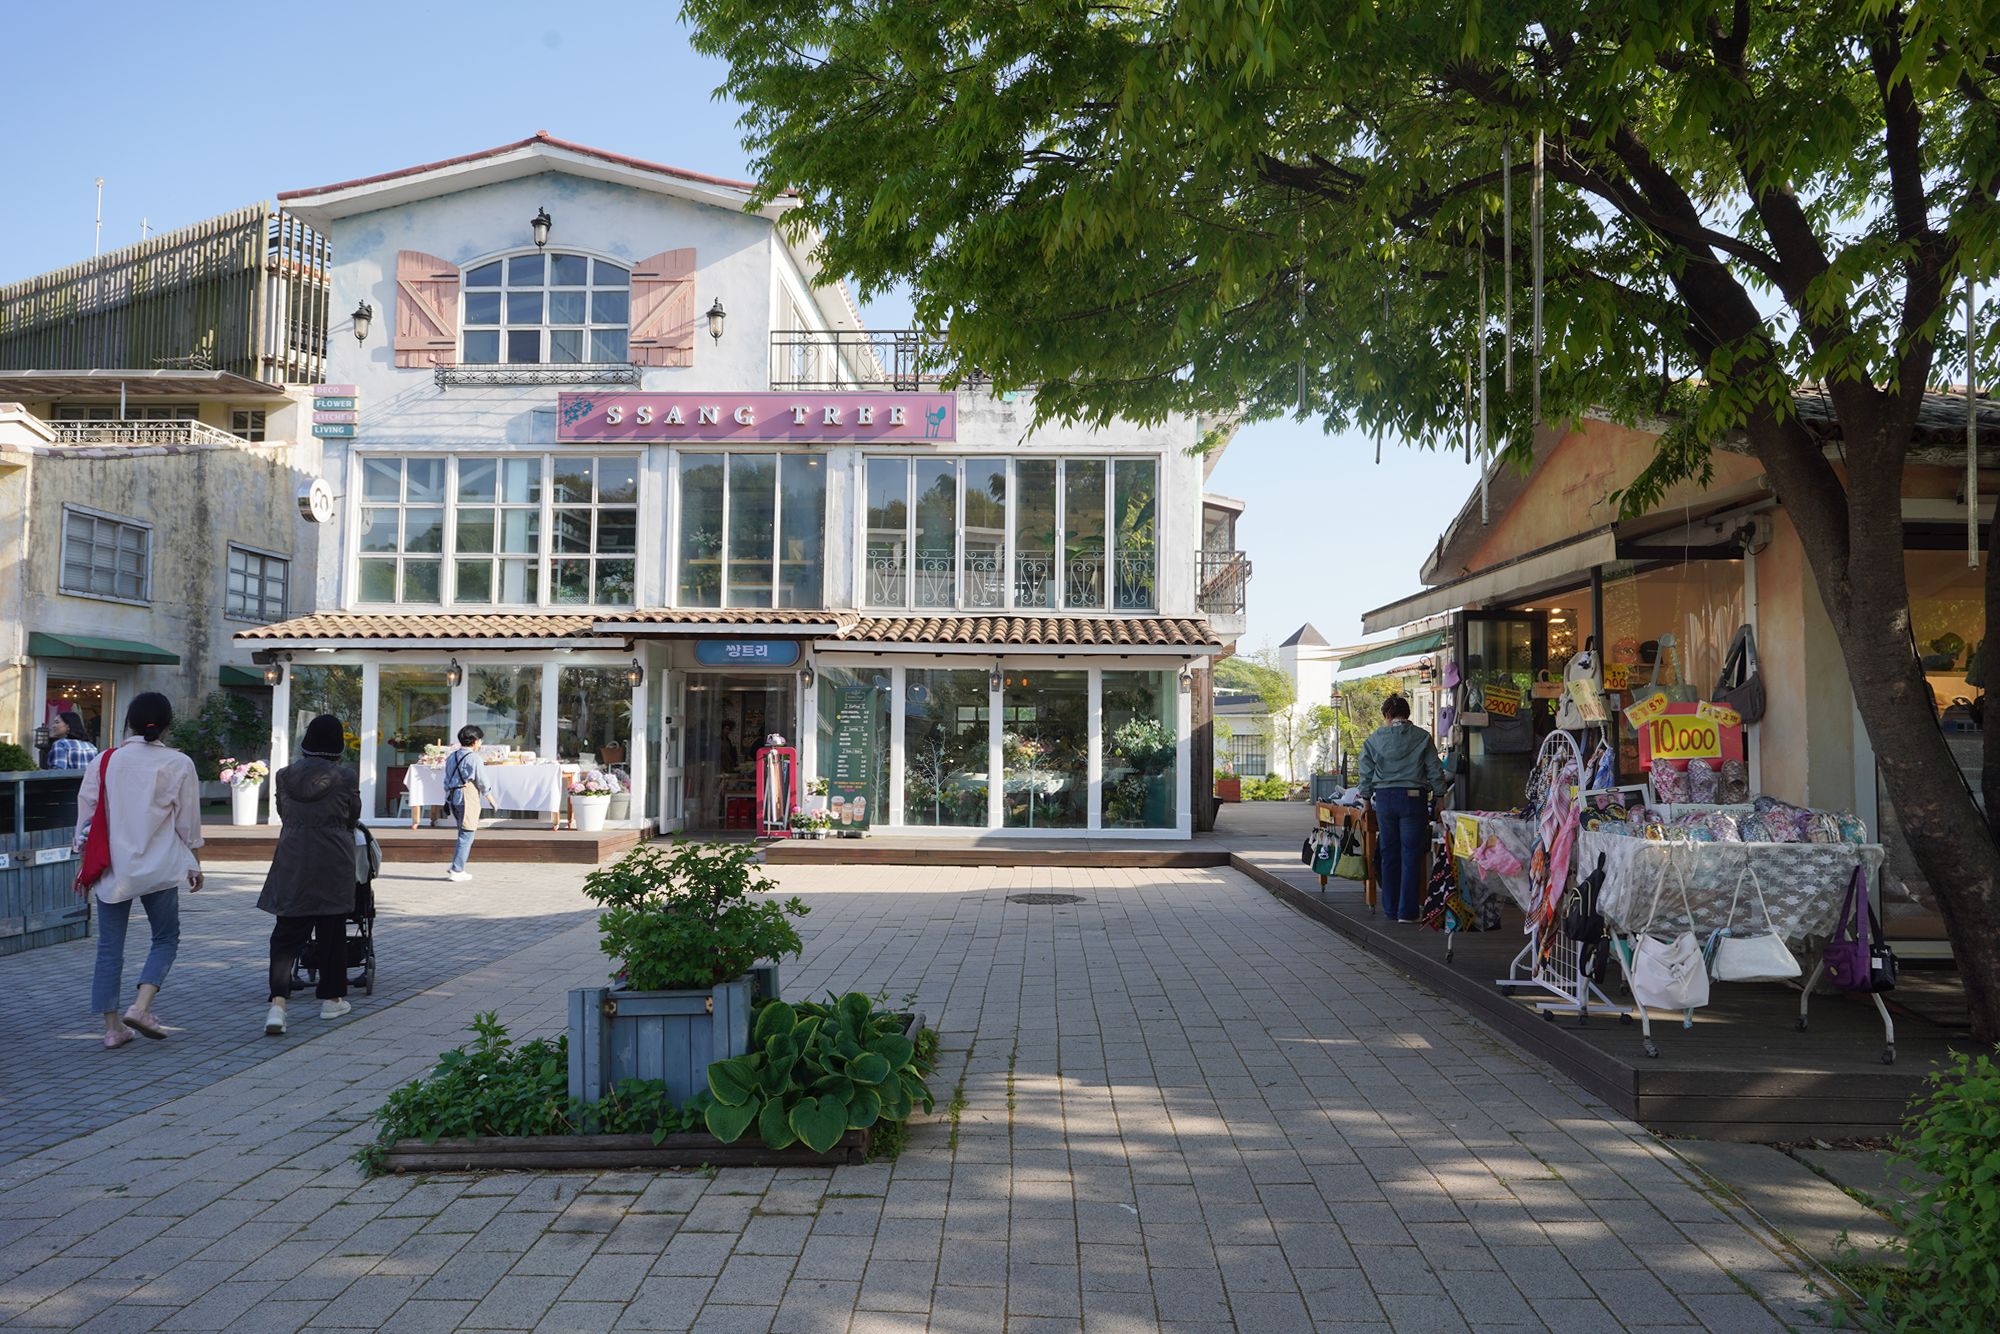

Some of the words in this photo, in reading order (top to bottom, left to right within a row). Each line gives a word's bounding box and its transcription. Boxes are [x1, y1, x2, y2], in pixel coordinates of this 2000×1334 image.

[606, 405, 754, 426] SSANG
[790, 405, 907, 426] TREE
[725, 644, 769, 658] 쌍트리
[1485, 698, 1517, 715] 29000
[1650, 718, 1716, 754] 10.000
